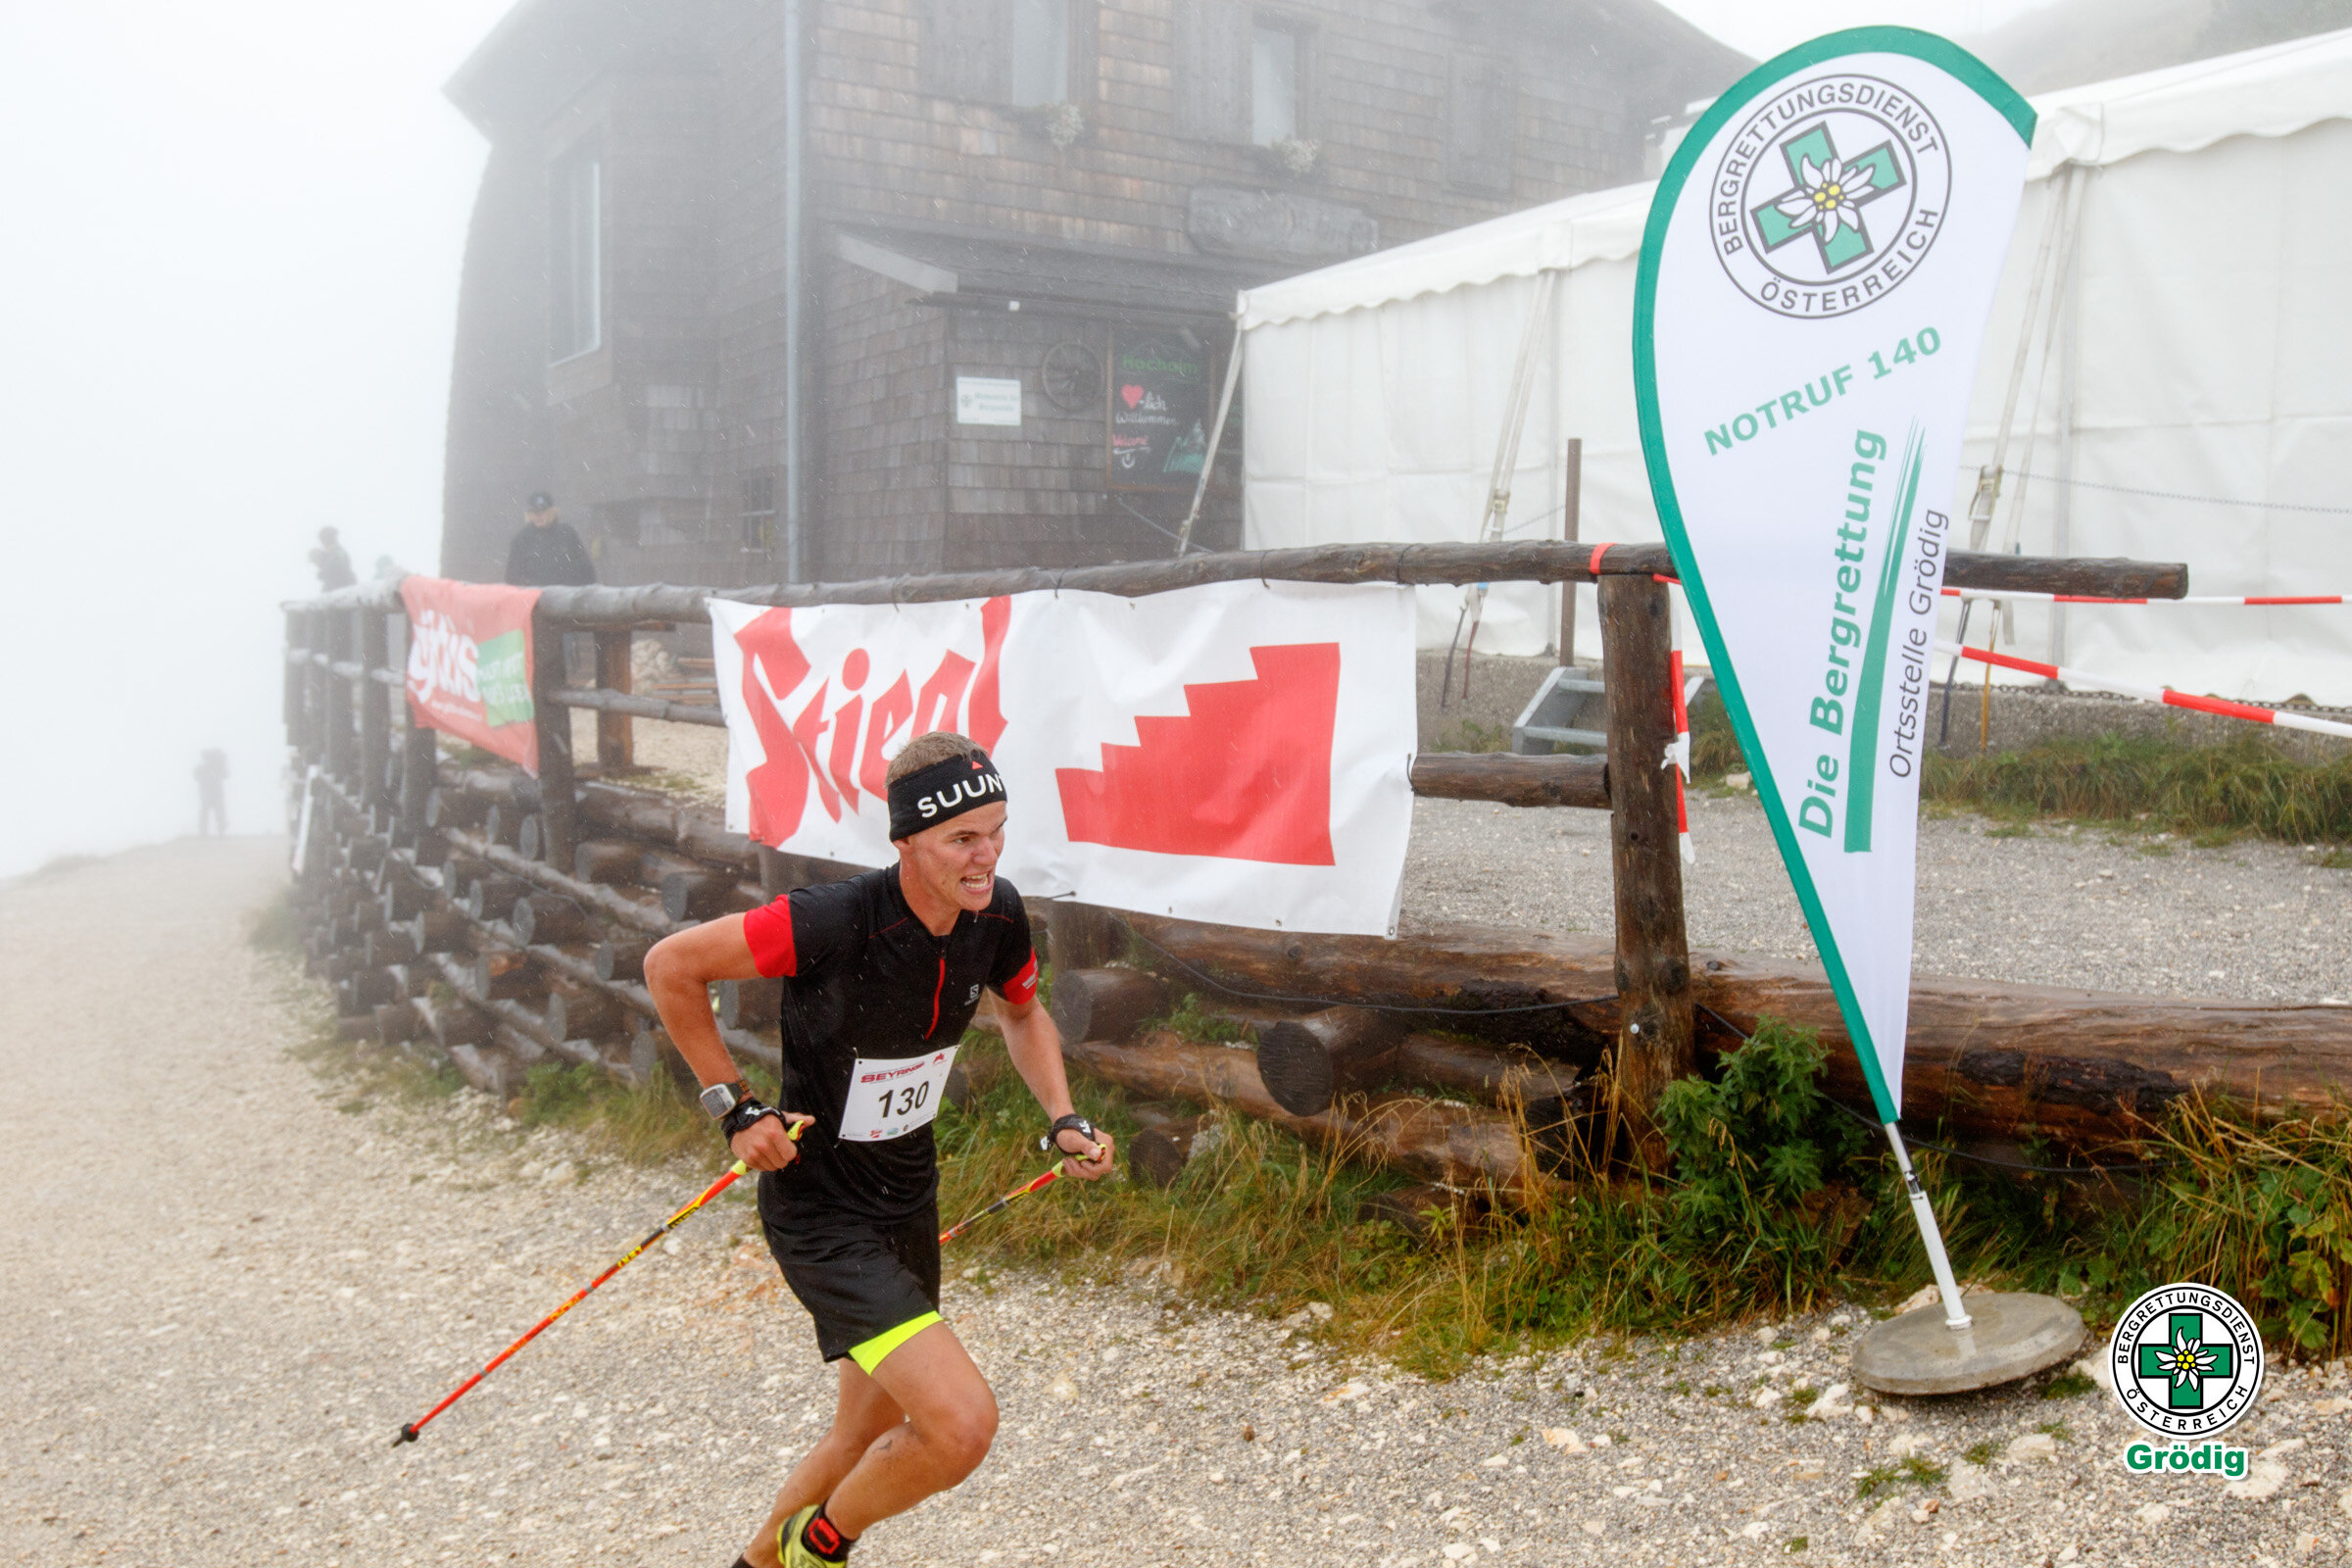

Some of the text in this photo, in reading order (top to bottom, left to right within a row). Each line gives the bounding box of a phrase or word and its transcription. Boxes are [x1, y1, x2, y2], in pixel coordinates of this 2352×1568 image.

[1718, 82, 1938, 256] BERGRETTUNGSDIENST
[1760, 209, 1938, 312] ÖSTERREICH
[1703, 326, 1941, 457] NOTRUF 140
[1797, 428, 1887, 839] Die Bergrettung
[1889, 509, 1949, 778] Ortsstelle Grödig
[878, 1080, 930, 1119] 130
